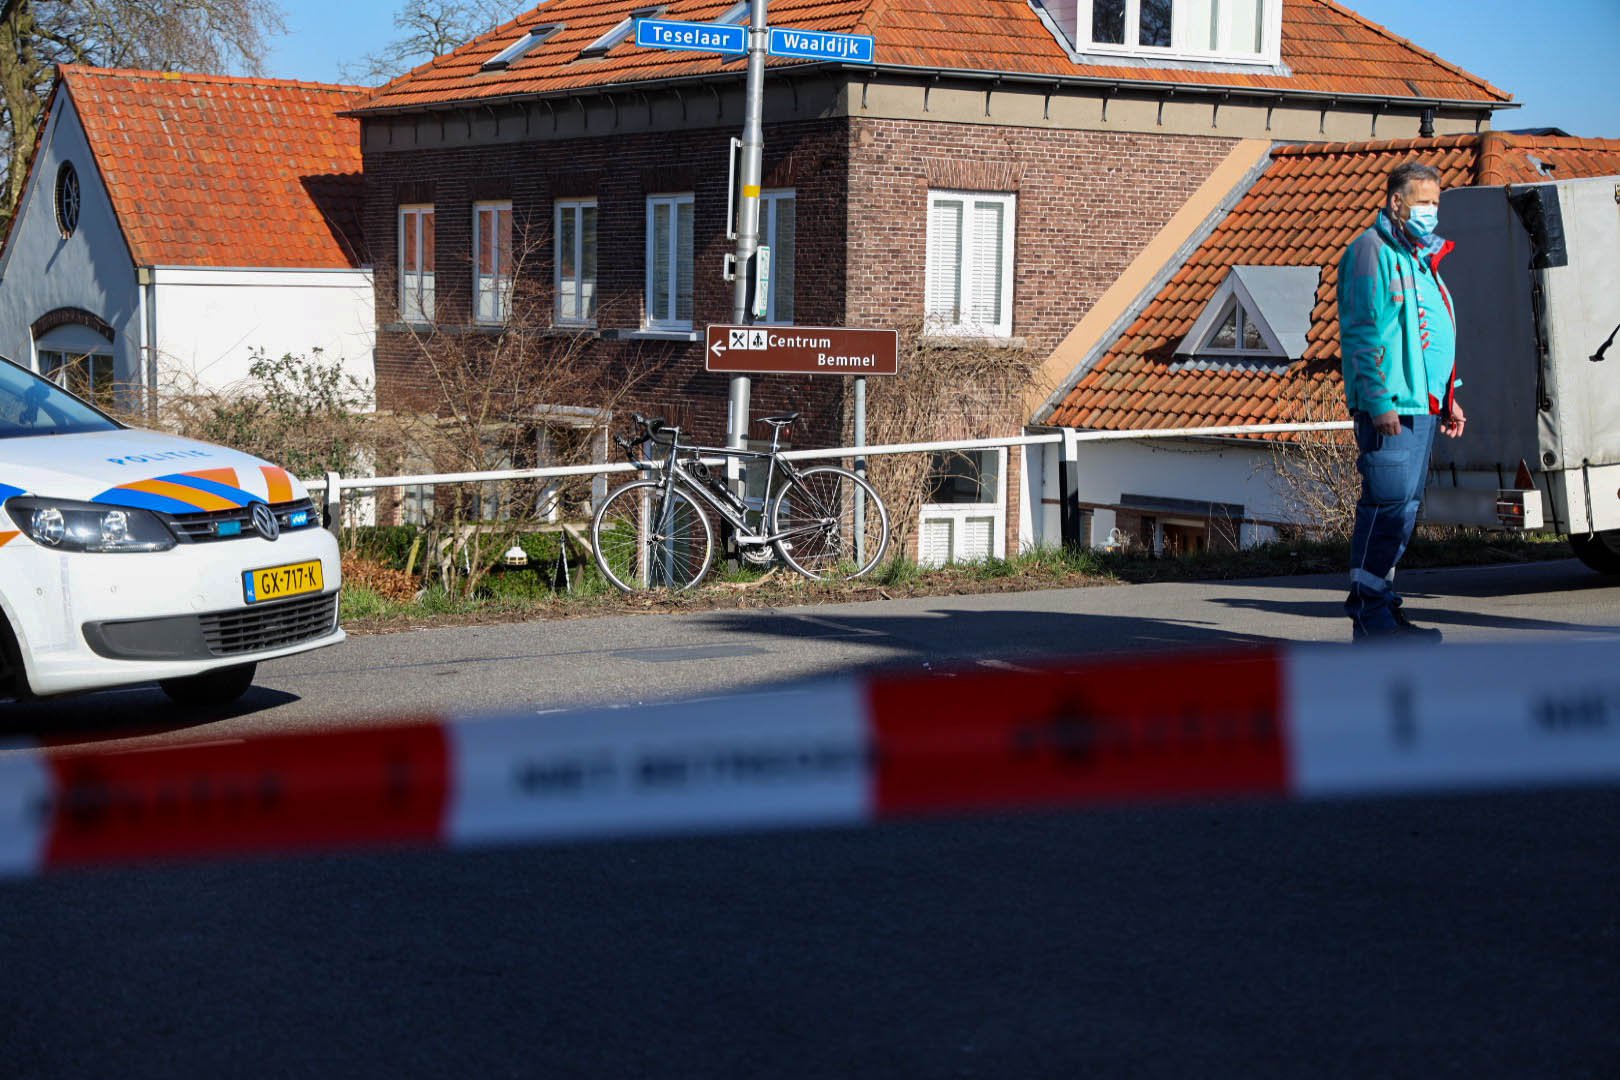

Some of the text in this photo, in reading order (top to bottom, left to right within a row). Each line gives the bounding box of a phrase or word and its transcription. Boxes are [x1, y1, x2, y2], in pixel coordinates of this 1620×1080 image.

[652, 26, 730, 46] Teselaar
[783, 33, 859, 57] Waaldijk
[768, 334, 831, 348] Centrum
[818, 353, 875, 367] Bemmel
[261, 566, 317, 595] GX-717-K
